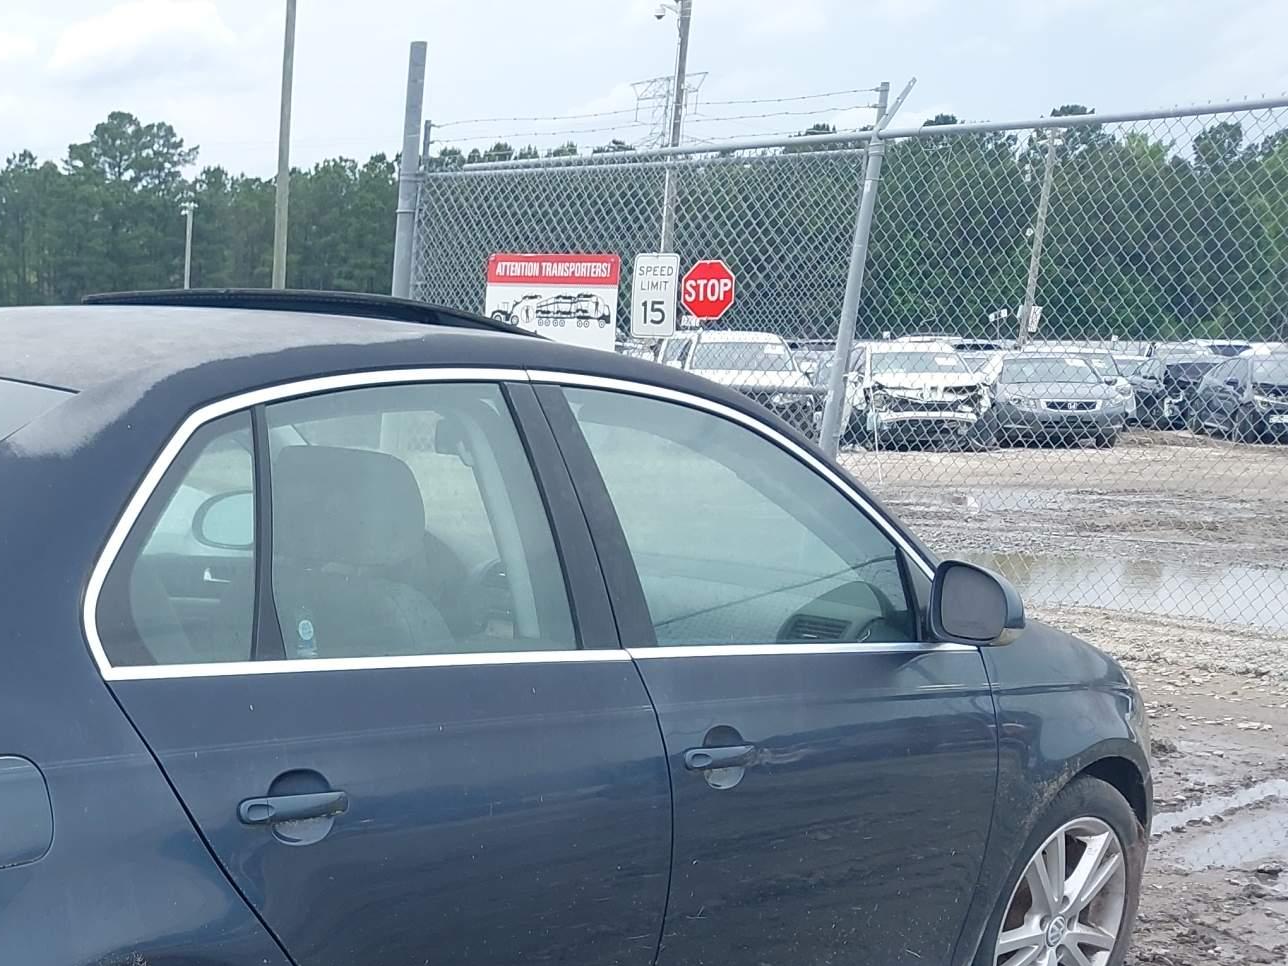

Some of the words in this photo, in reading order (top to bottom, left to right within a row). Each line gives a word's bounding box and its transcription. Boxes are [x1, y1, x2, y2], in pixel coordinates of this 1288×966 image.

[495, 262, 539, 277] ATTENTION
[541, 262, 611, 277] TRANSPORTERS!
[638, 265, 673, 276] SPEED
[640, 280, 669, 291] LIMIT
[684, 278, 732, 302] STOP
[641, 300, 666, 325] 15
